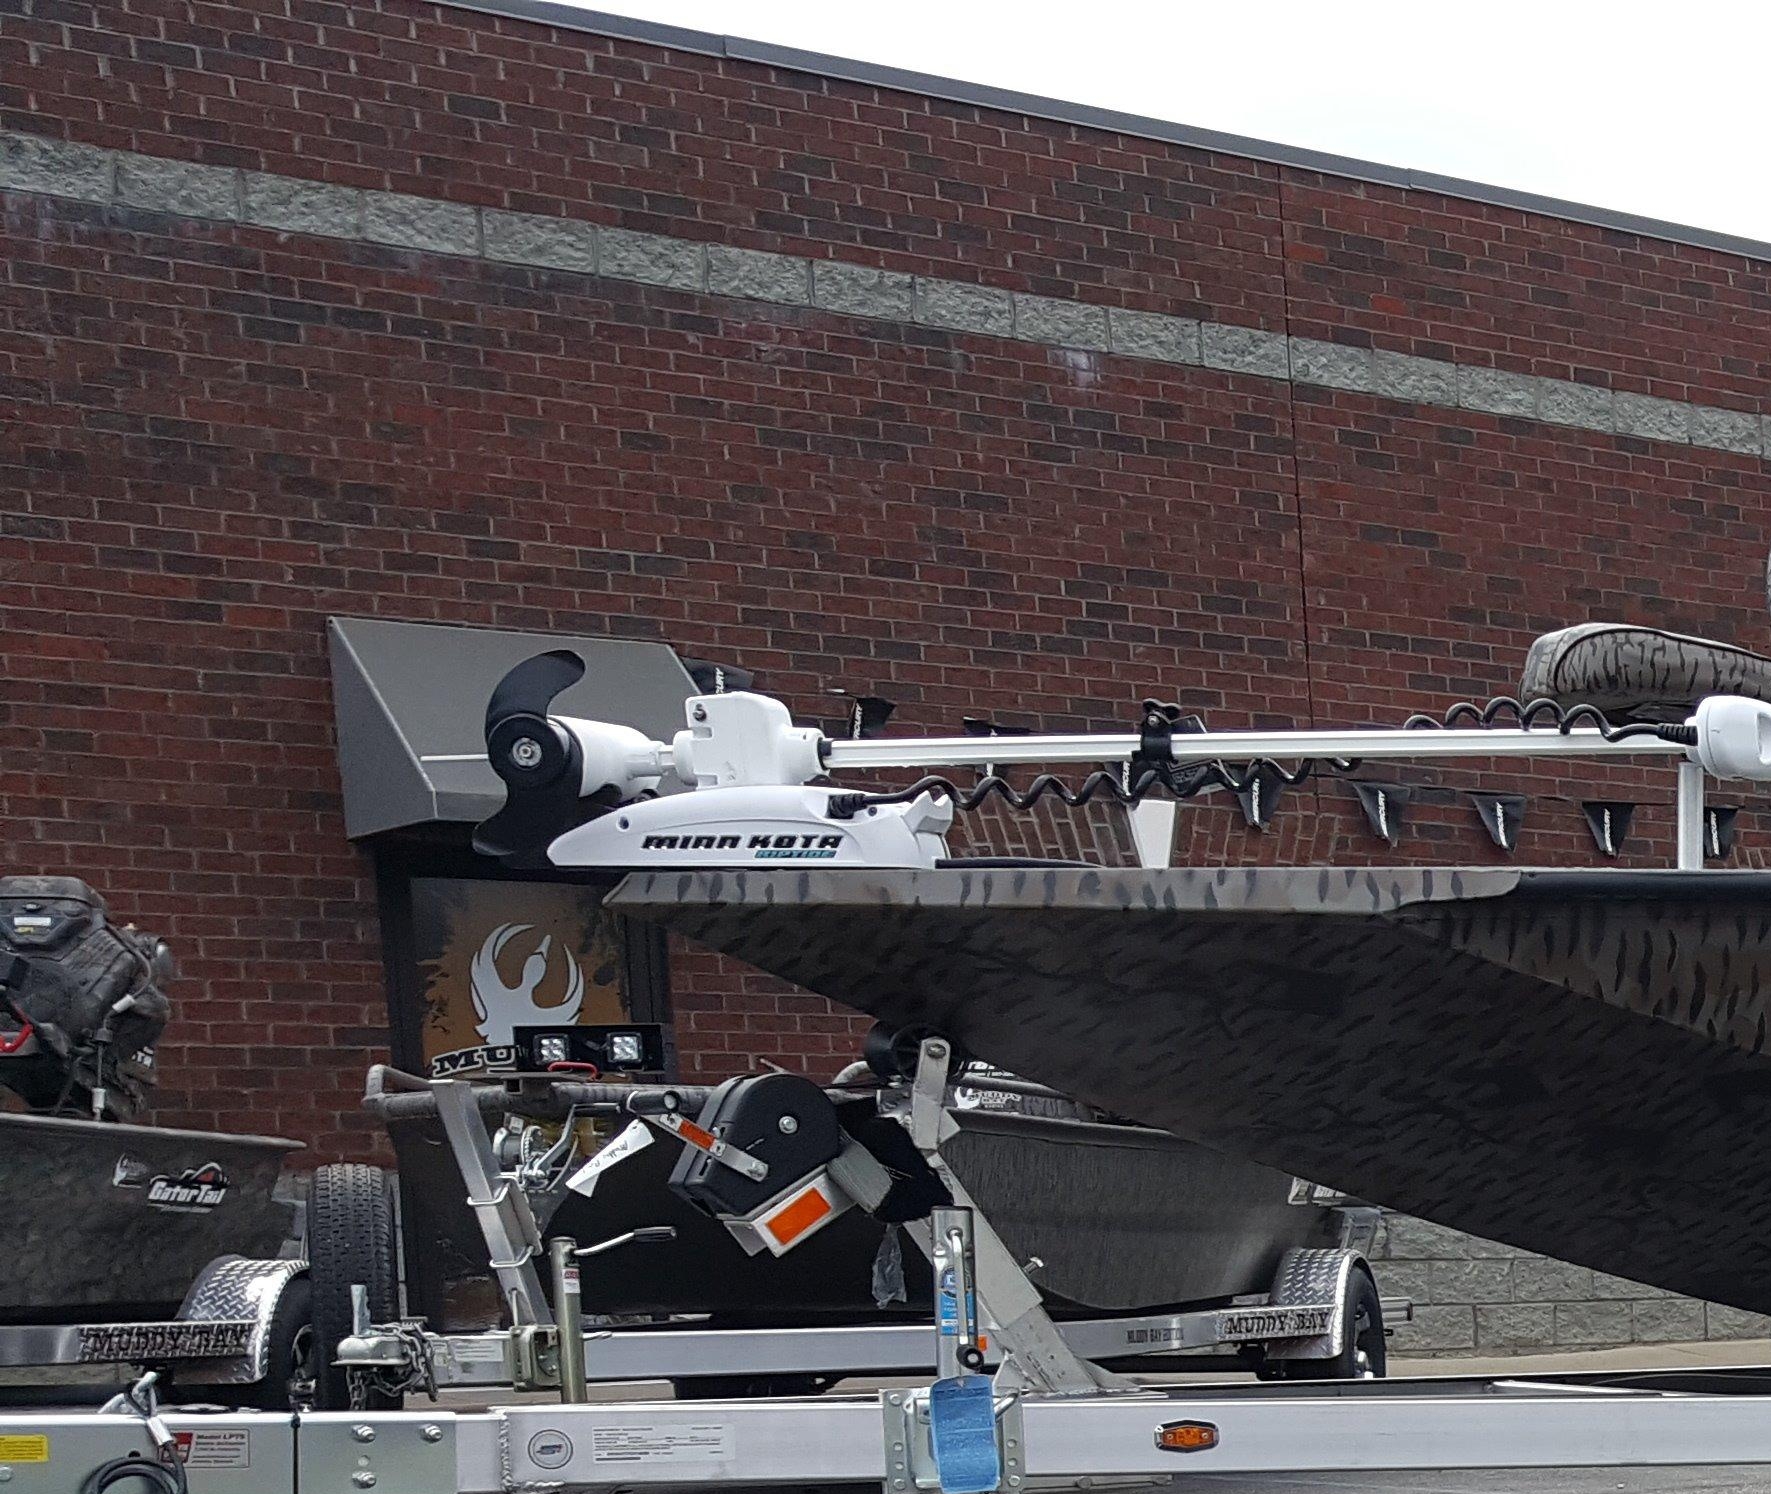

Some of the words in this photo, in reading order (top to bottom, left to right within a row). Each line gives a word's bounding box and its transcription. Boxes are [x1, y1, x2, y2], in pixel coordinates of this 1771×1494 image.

[715, 667, 726, 694] CURY
[853, 701, 864, 741] RCURY
[640, 835, 742, 850] MINN
[747, 835, 844, 849] KOTA
[432, 1044, 518, 1078] MU
[1227, 1314, 1288, 1335] MUDDY
[1295, 1312, 1329, 1330] BAY
